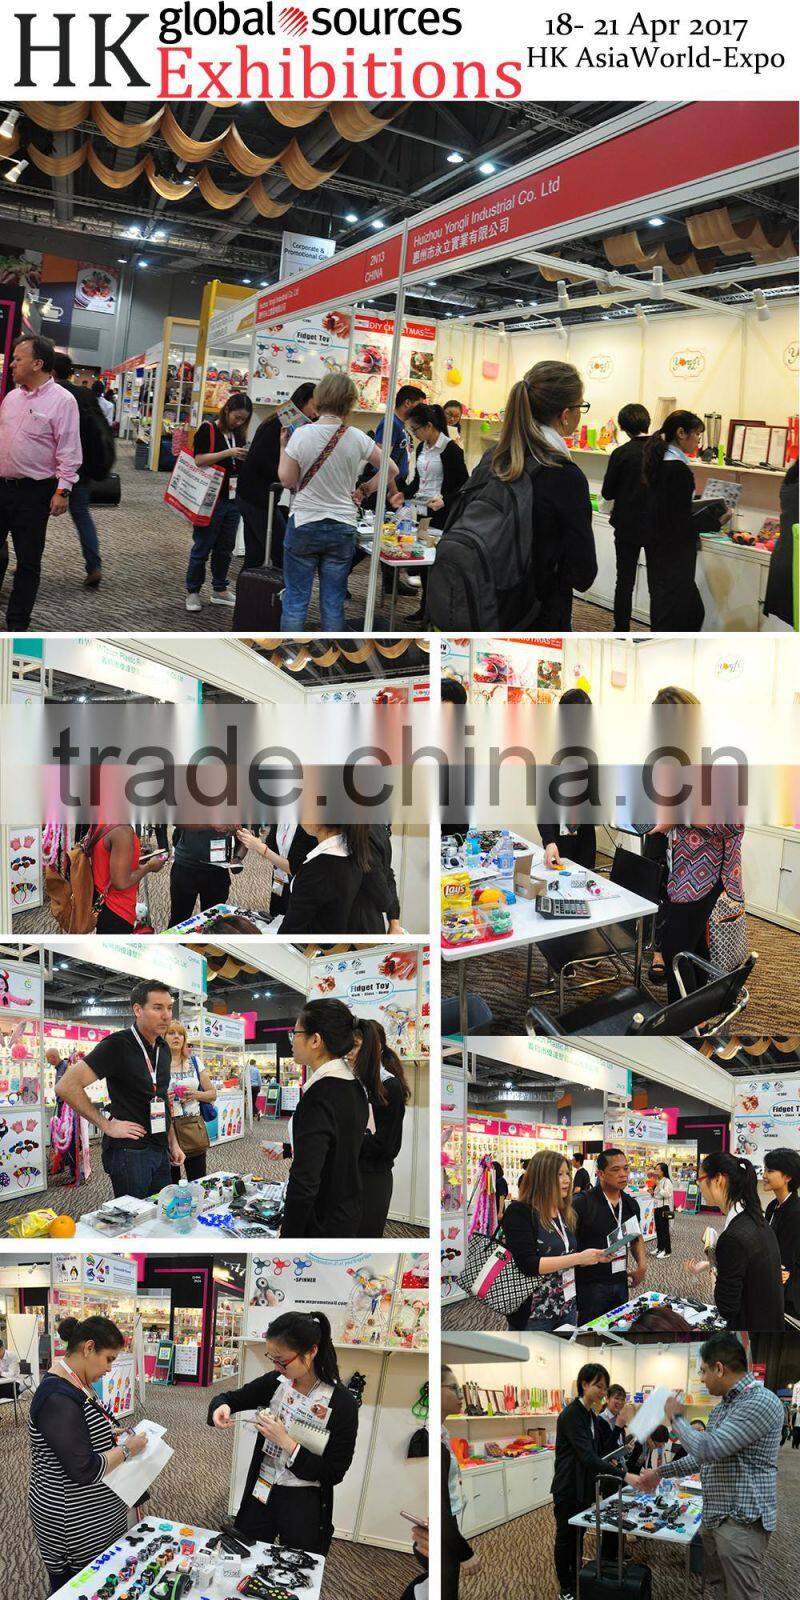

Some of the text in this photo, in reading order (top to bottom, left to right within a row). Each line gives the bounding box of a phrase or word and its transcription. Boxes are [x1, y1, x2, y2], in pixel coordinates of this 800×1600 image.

[413, 175, 561, 248] Huizhou Yongli Industrial Co. Ltd
[292, 241, 319, 253] Corporate
[284, 247, 317, 260] Promotional
[364, 268, 384, 284] CHINA
[369, 322, 383, 330] DIY
[383, 321, 425, 337] CHSTMAS
[297, 331, 317, 341] Fidget
[350, 982, 390, 993] Fidget Toy
[772, 1105, 794, 1113] Fidget
